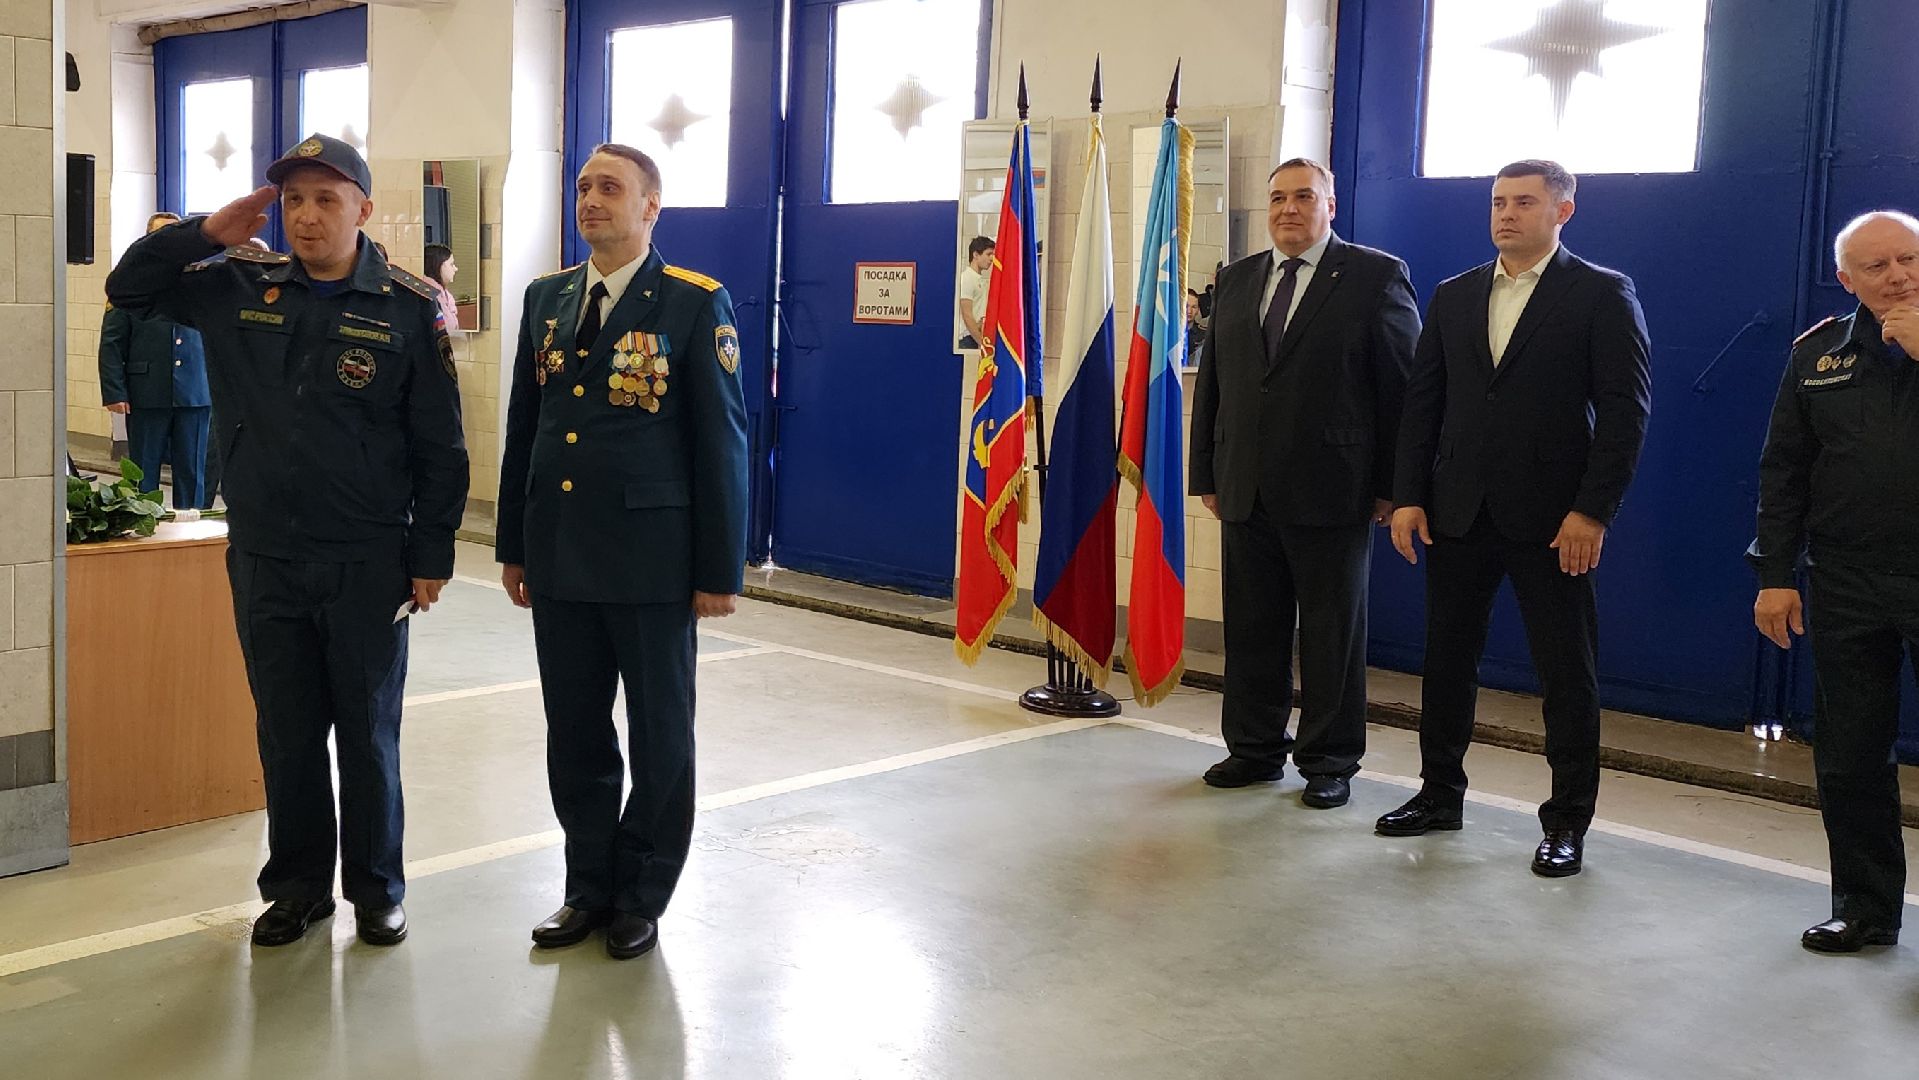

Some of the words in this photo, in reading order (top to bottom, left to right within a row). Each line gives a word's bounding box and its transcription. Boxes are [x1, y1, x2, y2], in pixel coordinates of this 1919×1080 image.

[864, 270, 907, 282] ПОСАДКА
[878, 288, 890, 298] ЗА
[858, 305, 909, 316] ВОРОТАМИ
